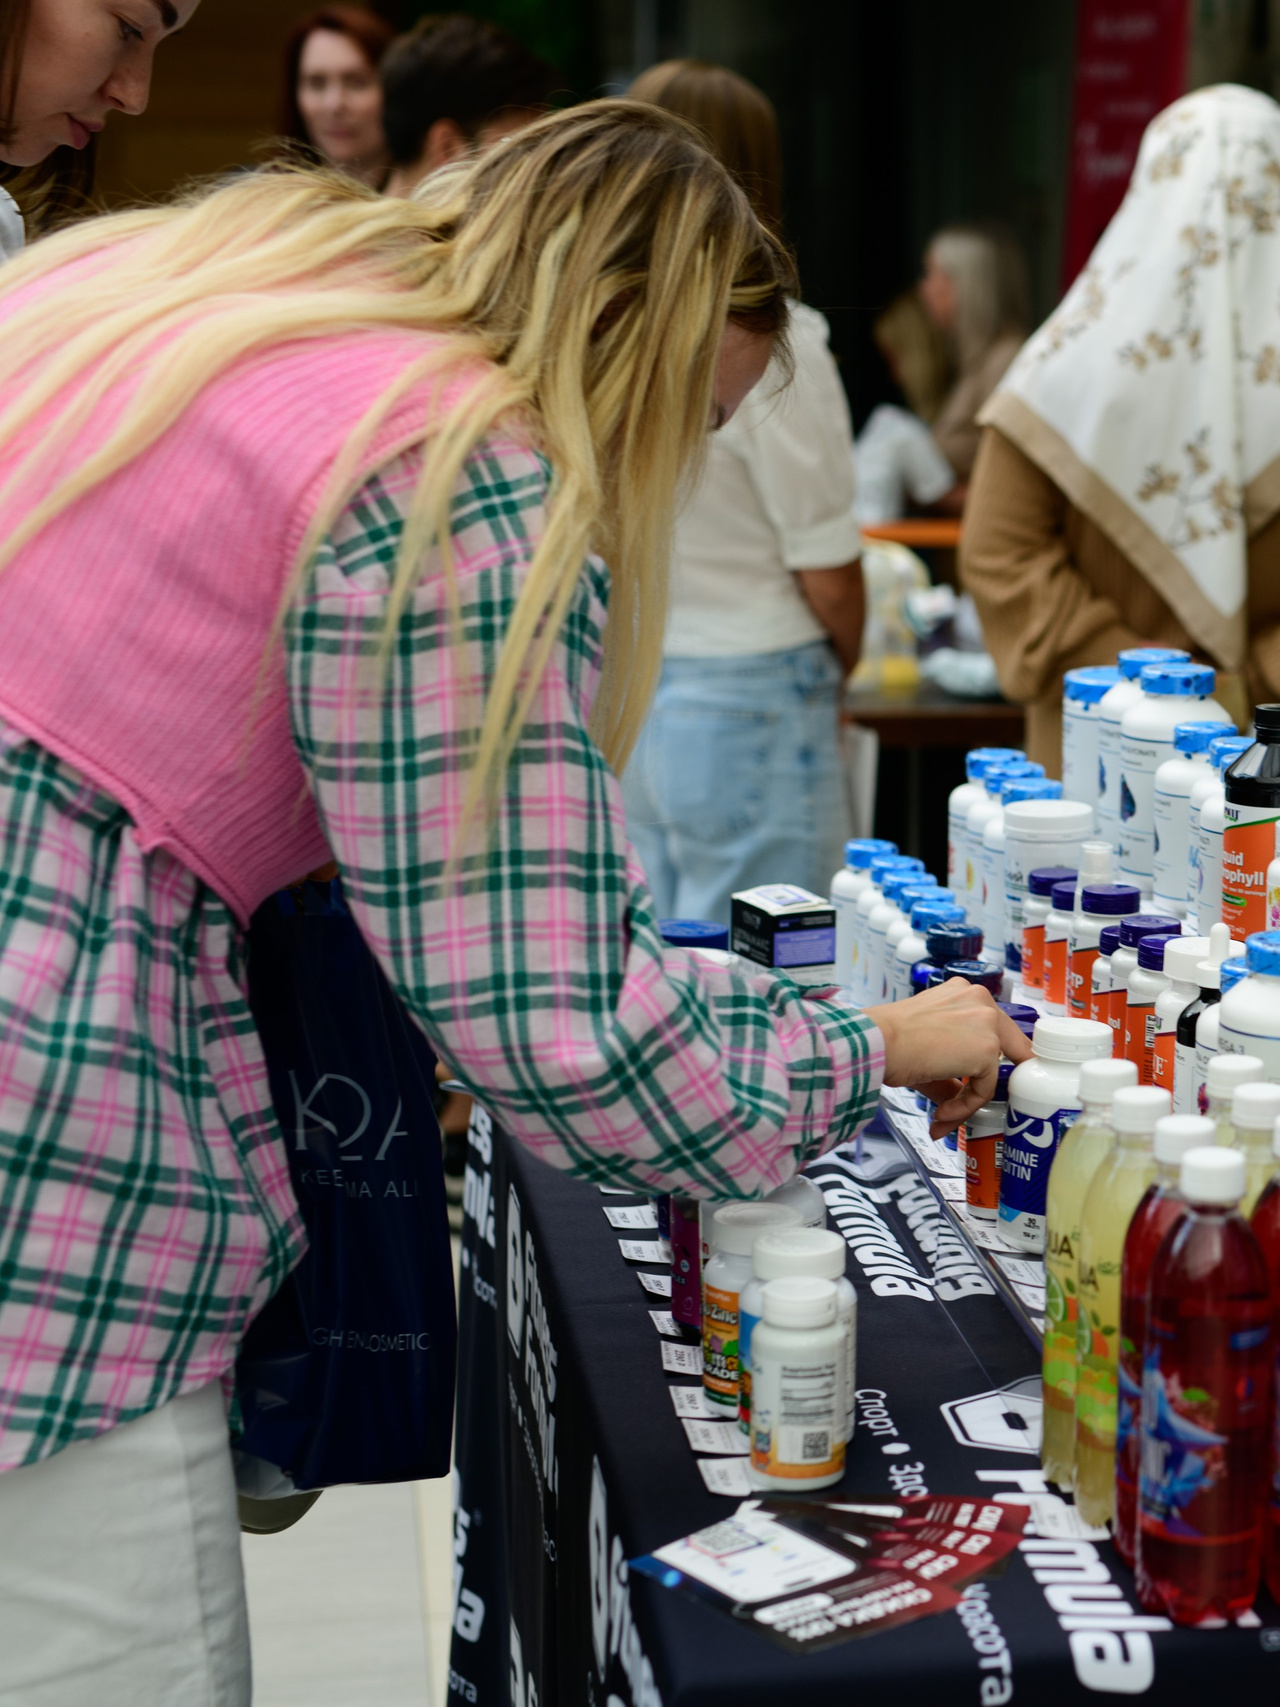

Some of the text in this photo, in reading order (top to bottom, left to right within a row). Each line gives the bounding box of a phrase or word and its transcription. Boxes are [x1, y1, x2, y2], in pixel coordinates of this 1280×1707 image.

[812, 1172, 936, 1302] Formula
[711, 1304, 738, 1323] Zinc
[854, 1388, 899, 1437] Спорт
